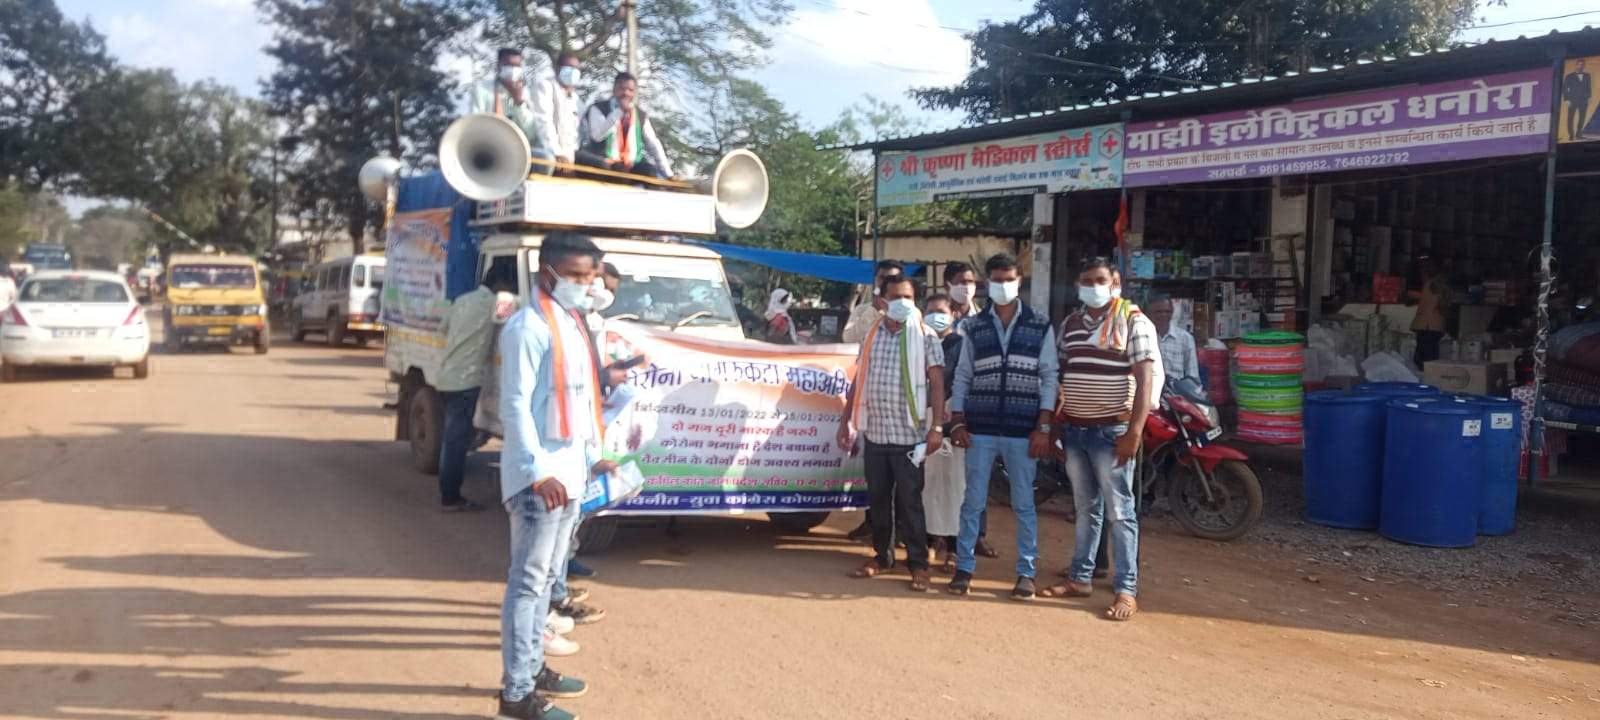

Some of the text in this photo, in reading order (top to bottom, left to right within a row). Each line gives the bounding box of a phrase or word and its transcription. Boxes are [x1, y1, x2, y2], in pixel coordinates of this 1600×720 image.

[1127, 119, 1204, 151] मांझी
[1407, 80, 1539, 119] धनोरा
[1309, 141, 1345, 154] उपलब्ध
[1359, 135, 1382, 150] इनसे
[1386, 128, 1434, 145] सम्बन्धित
[1437, 123, 1463, 139] कार्य
[1467, 120, 1495, 137] किये
[1497, 117, 1524, 134] जाते
[900, 131, 1093, 178] श्री कृष्णा मेडिकल स्टोर्स
[1208, 164, 1247, 179] सम्पर्क
[1334, 151, 1410, 168] 7646922792
[671, 419, 685, 432] दो
[715, 422, 737, 437] दूरी
[763, 457, 800, 468] अवश्य
